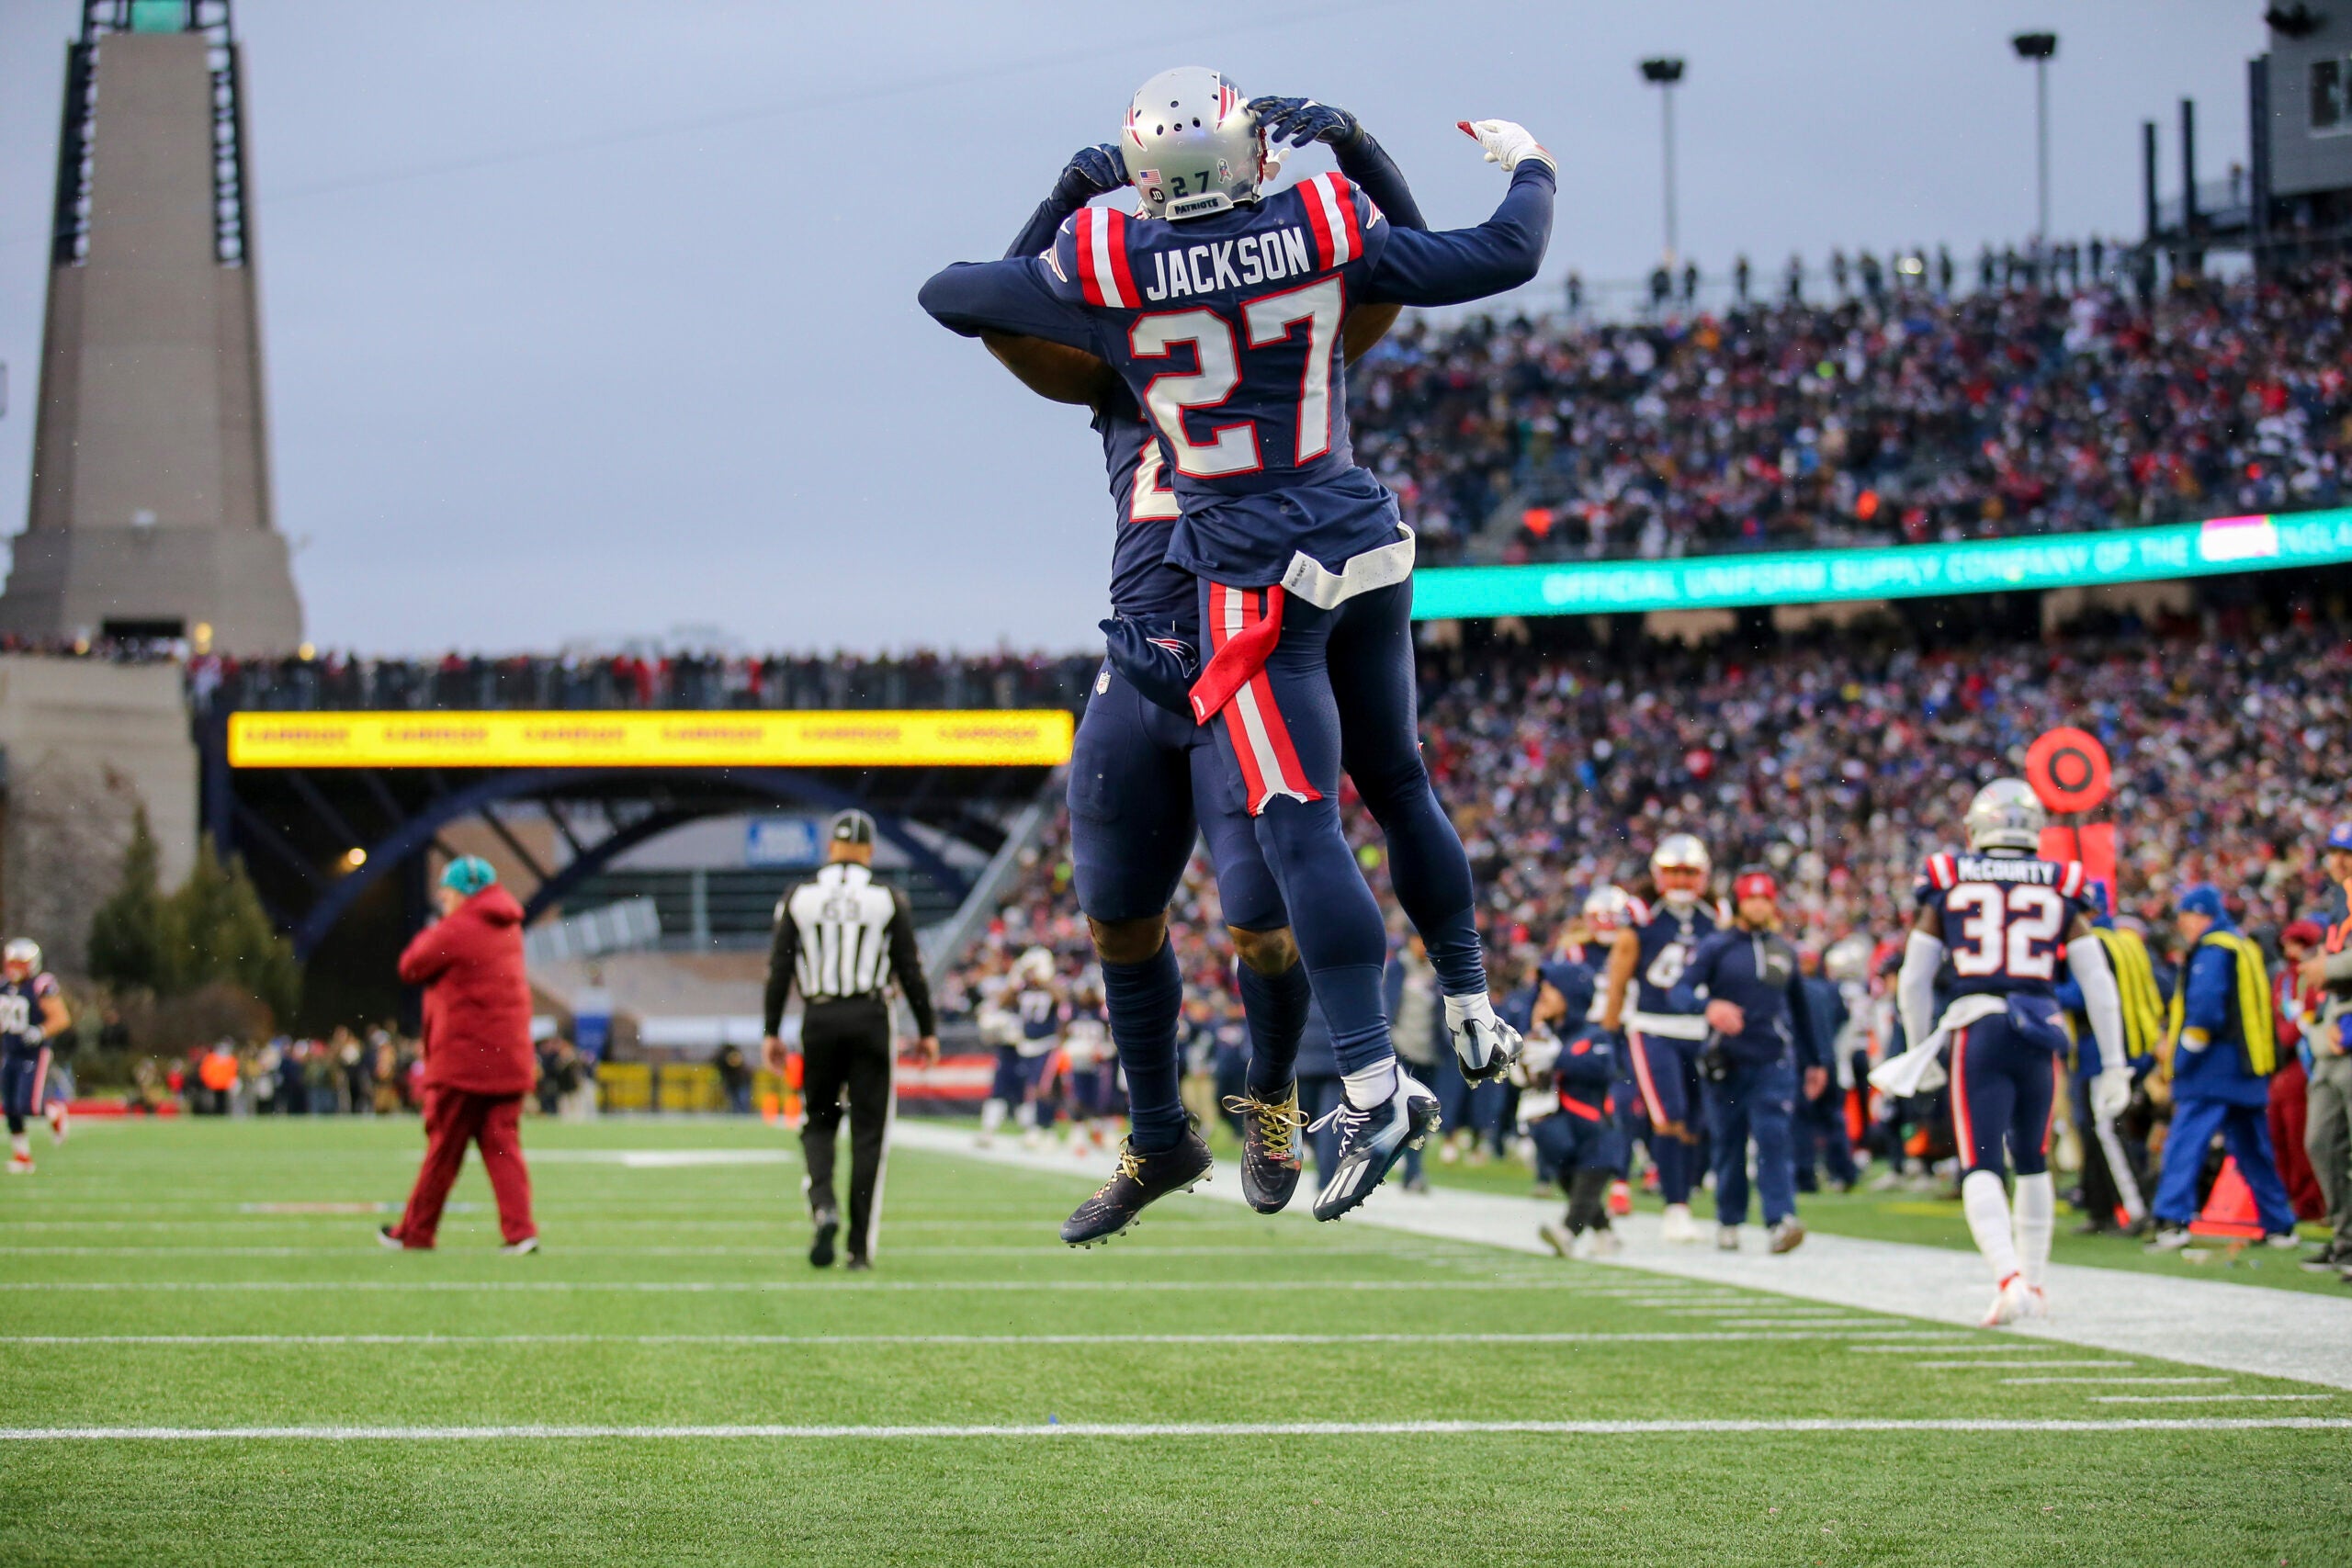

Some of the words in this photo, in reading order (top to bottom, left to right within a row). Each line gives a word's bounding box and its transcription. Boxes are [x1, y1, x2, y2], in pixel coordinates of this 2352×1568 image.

[1170, 170, 1210, 197] 27
[1174, 197, 1219, 215] PATRIOTS
[1147, 227, 1310, 301] JACKSON
[1127, 272, 1345, 479] 27
[1957, 857, 2055, 884] McCOURTY
[1946, 881, 2064, 981] 32
